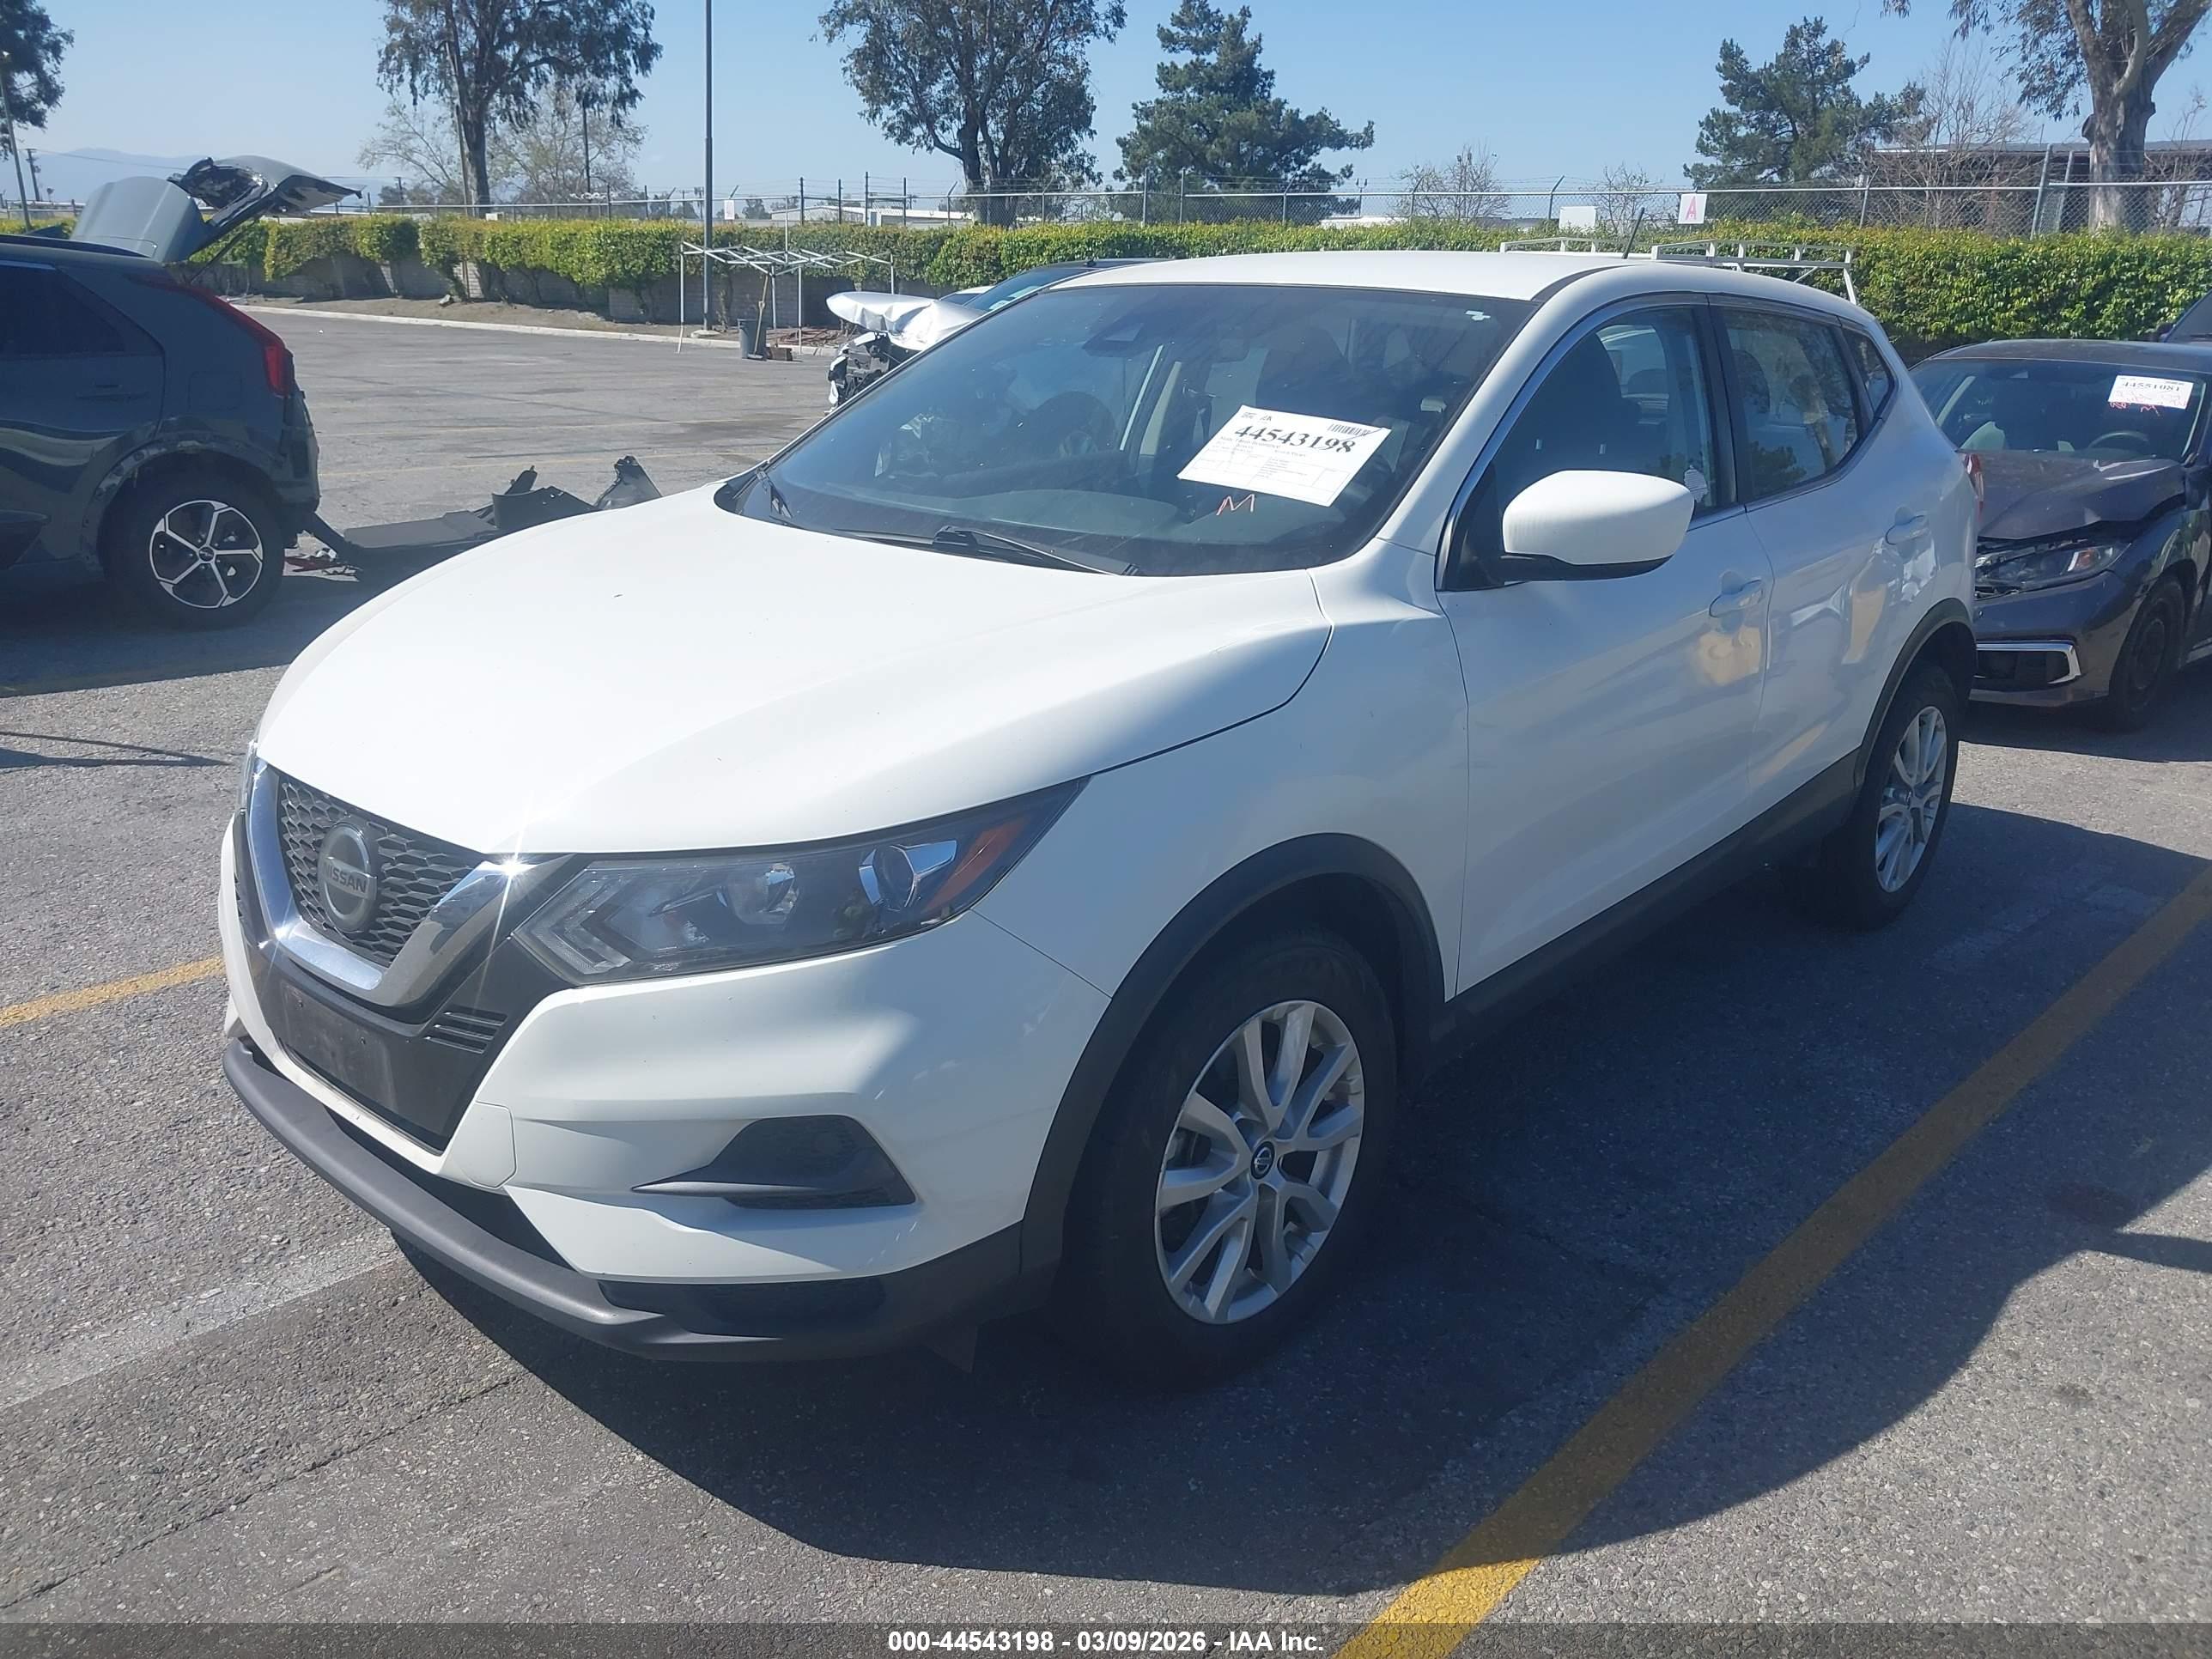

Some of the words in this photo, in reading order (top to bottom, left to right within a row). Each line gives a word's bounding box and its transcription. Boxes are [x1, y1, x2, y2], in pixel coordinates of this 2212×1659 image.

[1686, 196, 1696, 220] A
[1234, 425, 1357, 453] 44543198
[1216, 494, 1255, 515] M
[324, 862, 367, 893] NISSAN
